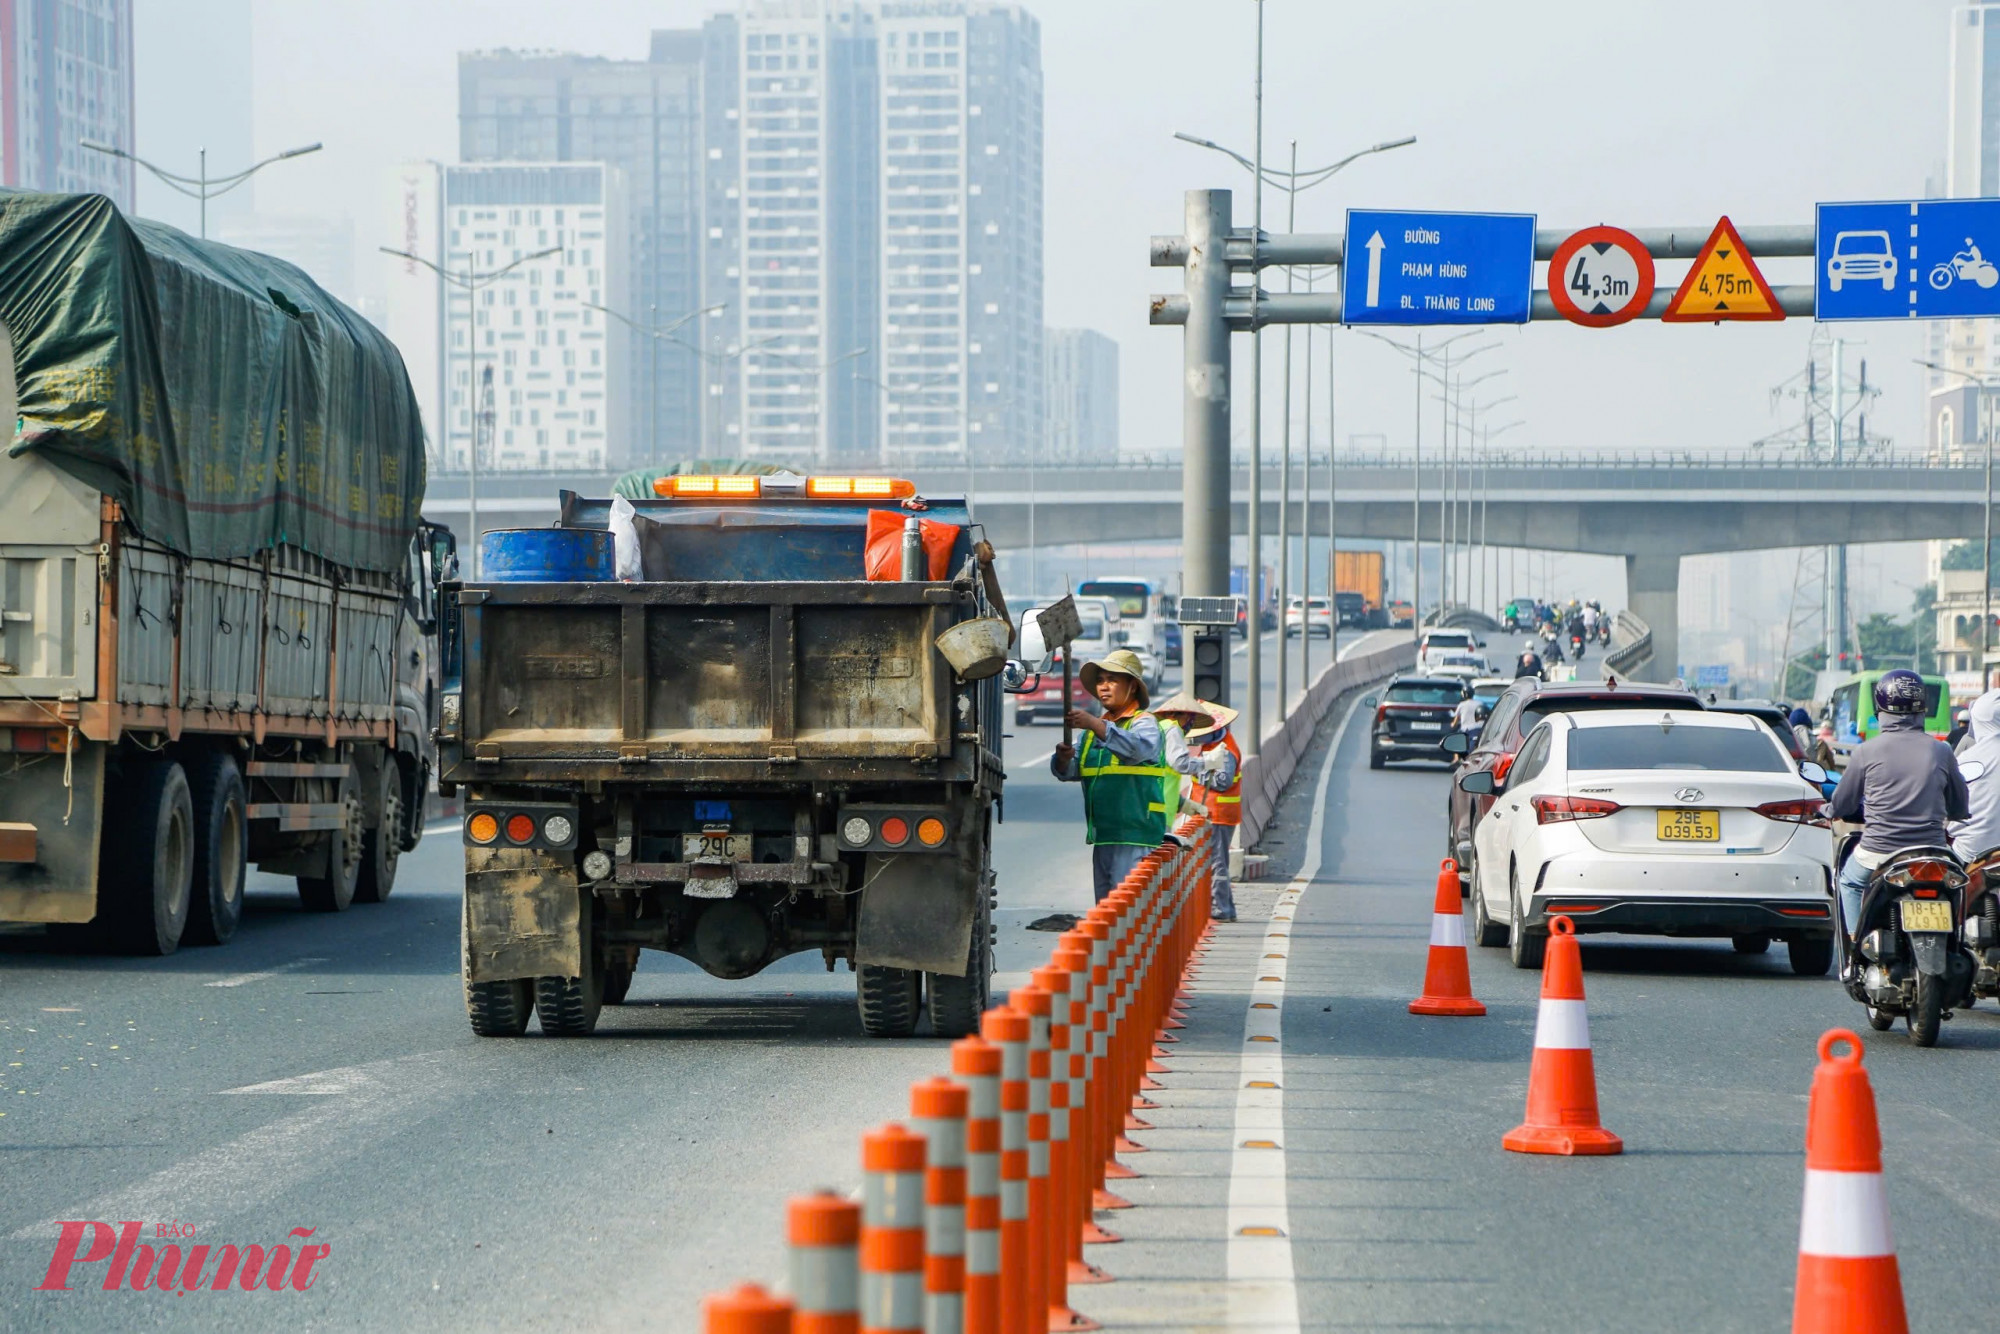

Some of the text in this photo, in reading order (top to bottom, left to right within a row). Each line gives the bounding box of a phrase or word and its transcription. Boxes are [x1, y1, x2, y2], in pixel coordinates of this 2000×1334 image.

[1404, 226, 1440, 244] ĐƯỜNG
[1402, 260, 1467, 280] PHẠM HÙNG
[1571, 257, 1629, 299] 4,3m
[1401, 294, 1495, 311] ĐL. THĂNG LONG
[1675, 811, 1701, 825] 29E
[1664, 825, 1713, 839] 039.53
[699, 836, 735, 858] 29C
[1909, 902, 1943, 916] 18-E1
